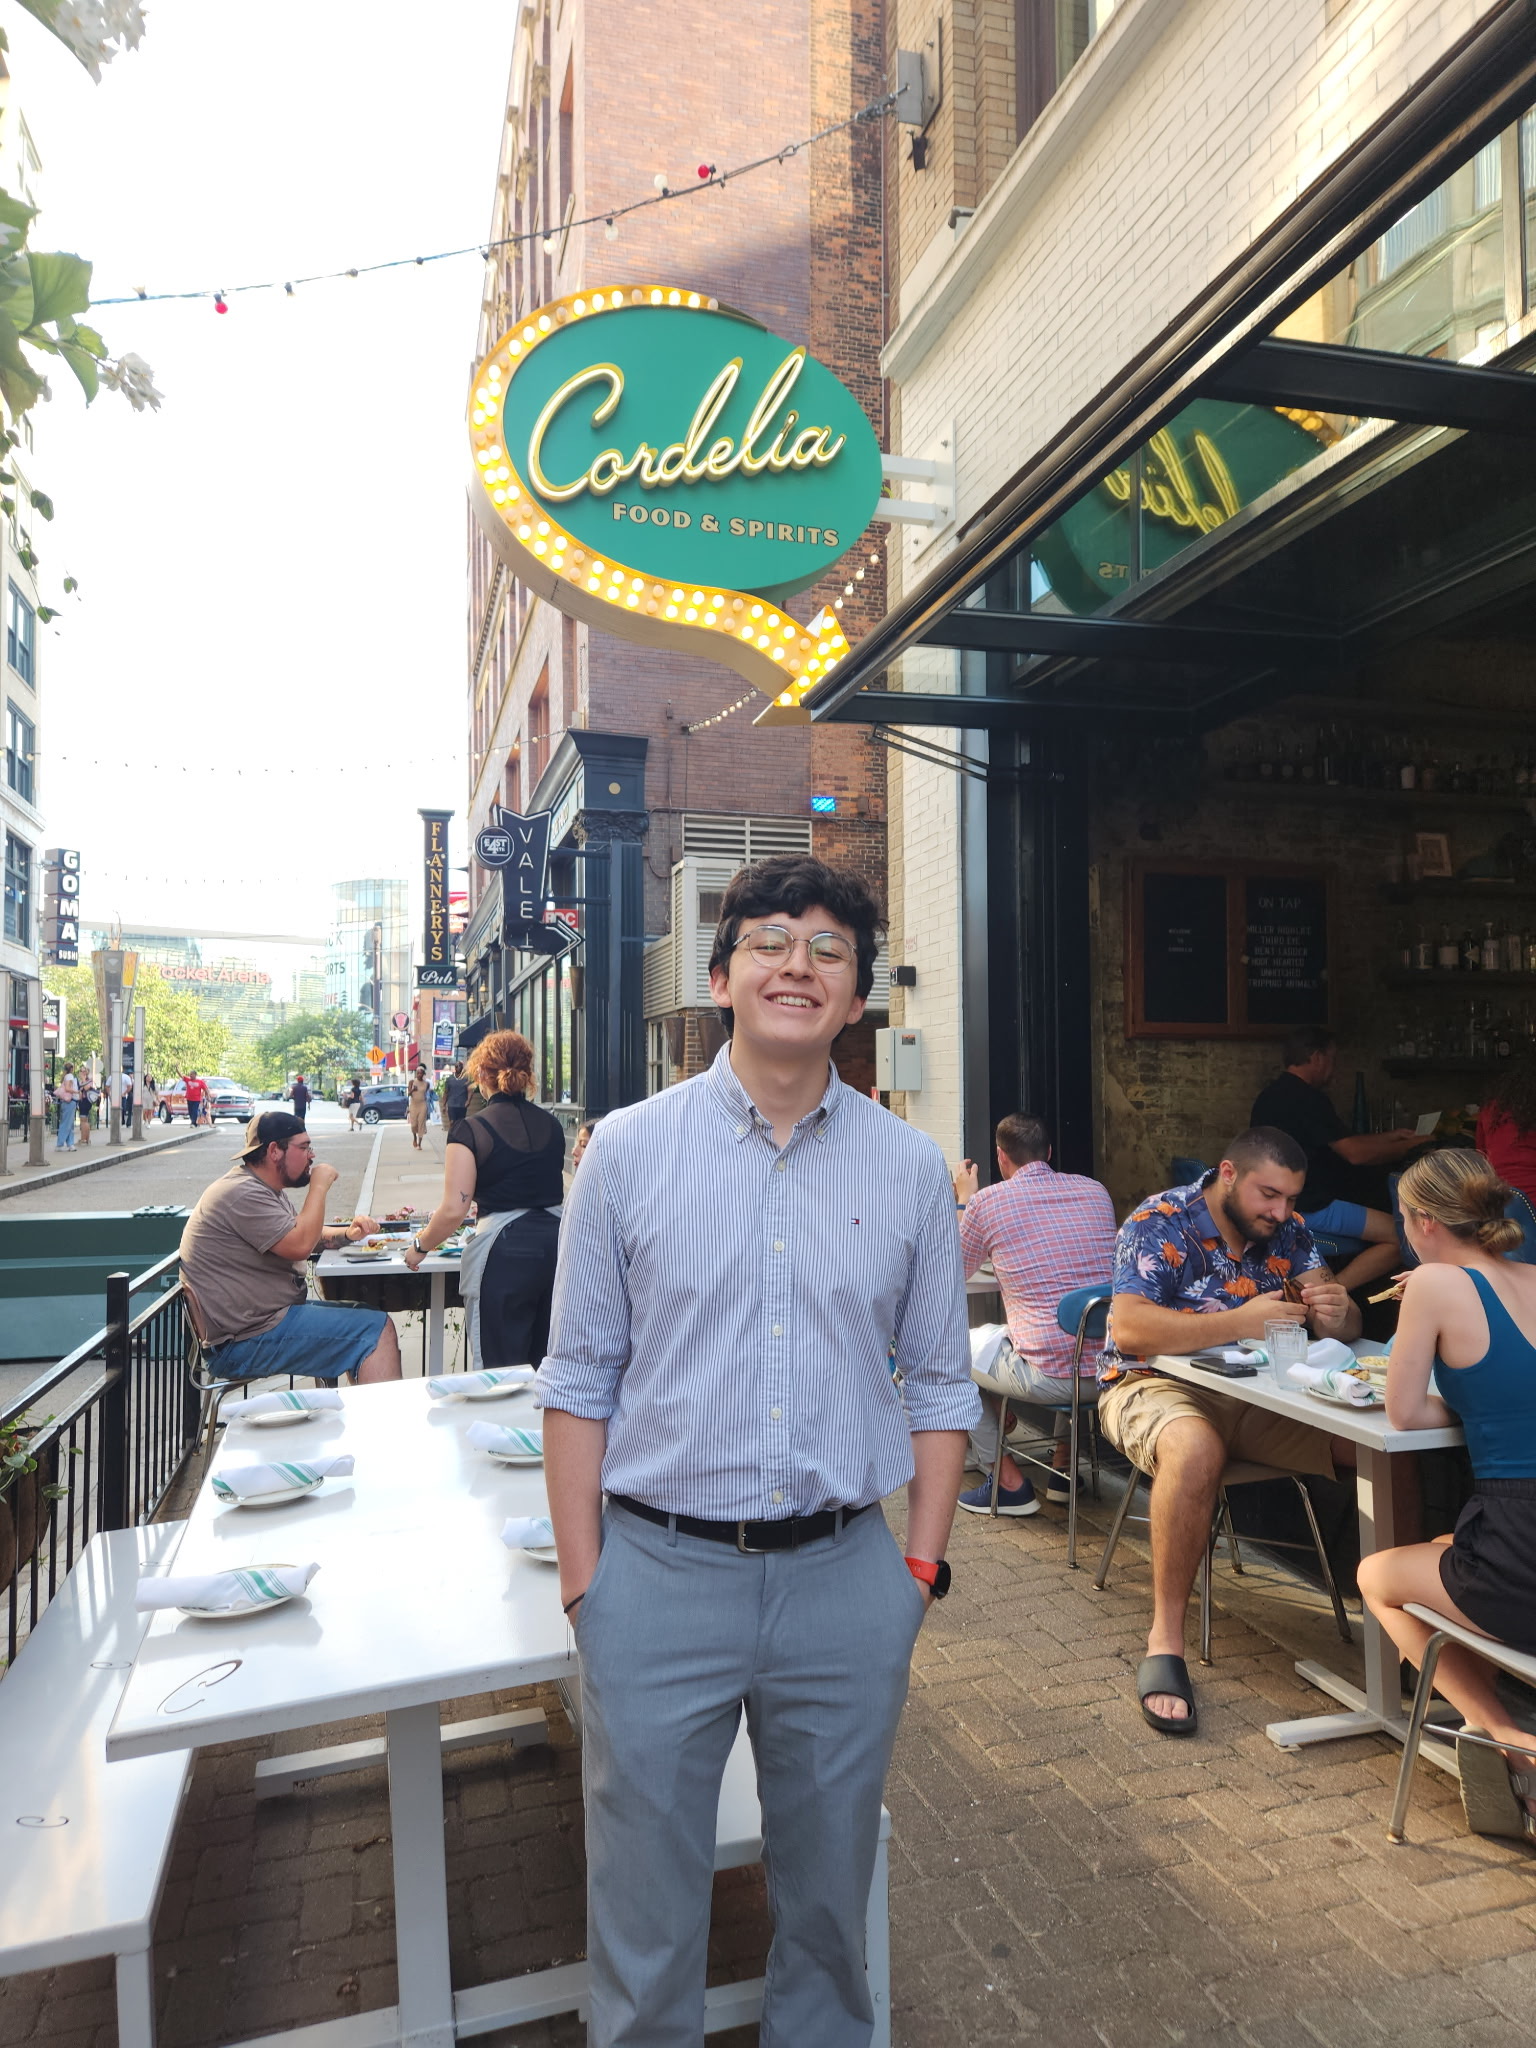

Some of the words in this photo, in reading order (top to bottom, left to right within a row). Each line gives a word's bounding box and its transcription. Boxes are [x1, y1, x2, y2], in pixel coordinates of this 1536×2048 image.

[528, 345, 847, 503] Cordelia
[612, 502, 692, 531] FOOD
[700, 513, 721, 533] &
[730, 517, 840, 547] SPIRITS
[59, 851, 78, 940] GOMA
[430, 821, 446, 961] FLANNERYS
[58, 949, 78, 961] SUSHI
[217, 967, 271, 984] Arena
[419, 970, 453, 984] Pub
